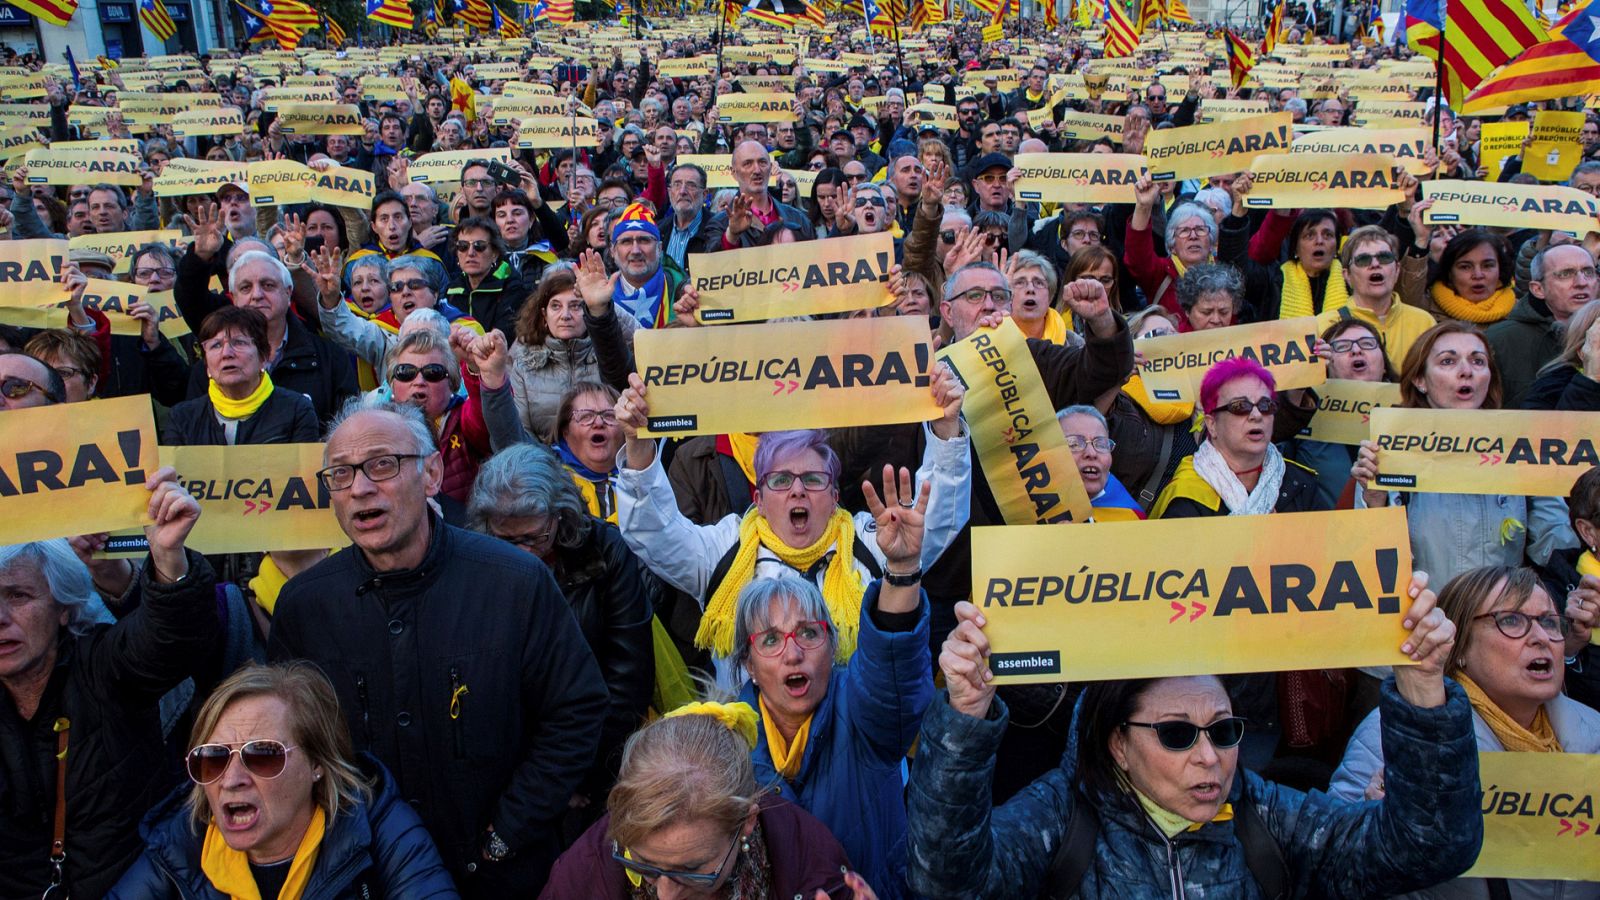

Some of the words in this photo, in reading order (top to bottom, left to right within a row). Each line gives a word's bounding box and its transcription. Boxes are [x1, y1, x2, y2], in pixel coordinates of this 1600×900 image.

[108, 6, 124, 16] BBVA
[686, 61, 708, 70] ARA!
[1315, 85, 1338, 94] ARA!
[1381, 84, 1410, 93] ARA!
[196, 99, 220, 107] ARA!
[304, 92, 334, 102] ARA!
[533, 104, 565, 115] ARA!
[760, 101, 794, 112] ARA!
[280, 113, 324, 121] REPÚBLICA
[325, 112, 361, 125] ARA!
[1393, 108, 1425, 119] ARA!
[210, 114, 242, 126] ARA!
[1066, 120, 1104, 129] REPÚBLICA
[561, 125, 596, 137] ARA!
[1150, 140, 1226, 159] REPÚBLICA
[1226, 126, 1288, 155] ARA!
[27, 159, 87, 169] REPÚBLICA
[1020, 167, 1088, 179] REPÚBLICA
[1249, 169, 1328, 183] REPÚBLICA
[1328, 167, 1399, 190] ARA!
[194, 174, 236, 185] ARA!
[252, 170, 316, 184] REPÚBLICA
[317, 175, 372, 197] ARA!
[1430, 192, 1518, 206] REPÚBLICA
[696, 266, 800, 291] REPÚBLICA
[802, 252, 890, 289] ARA!
[1144, 348, 1236, 372] REPÚBLICA
[1241, 334, 1319, 366] ARA!
[644, 356, 801, 387] REPÚBLICA
[803, 343, 930, 390] ARA!
[970, 334, 1033, 440] REPÚBLICA
[653, 419, 693, 428] assemblea
[1377, 432, 1504, 453] REPÚBLICA
[1380, 476, 1412, 484] assemblea
[108, 539, 148, 548] assemble
[983, 565, 1210, 607] REPÚBLICA
[1213, 548, 1400, 616] ARA!
[998, 657, 1053, 669] assemblea
[1482, 785, 1594, 819] ÚBLICA
